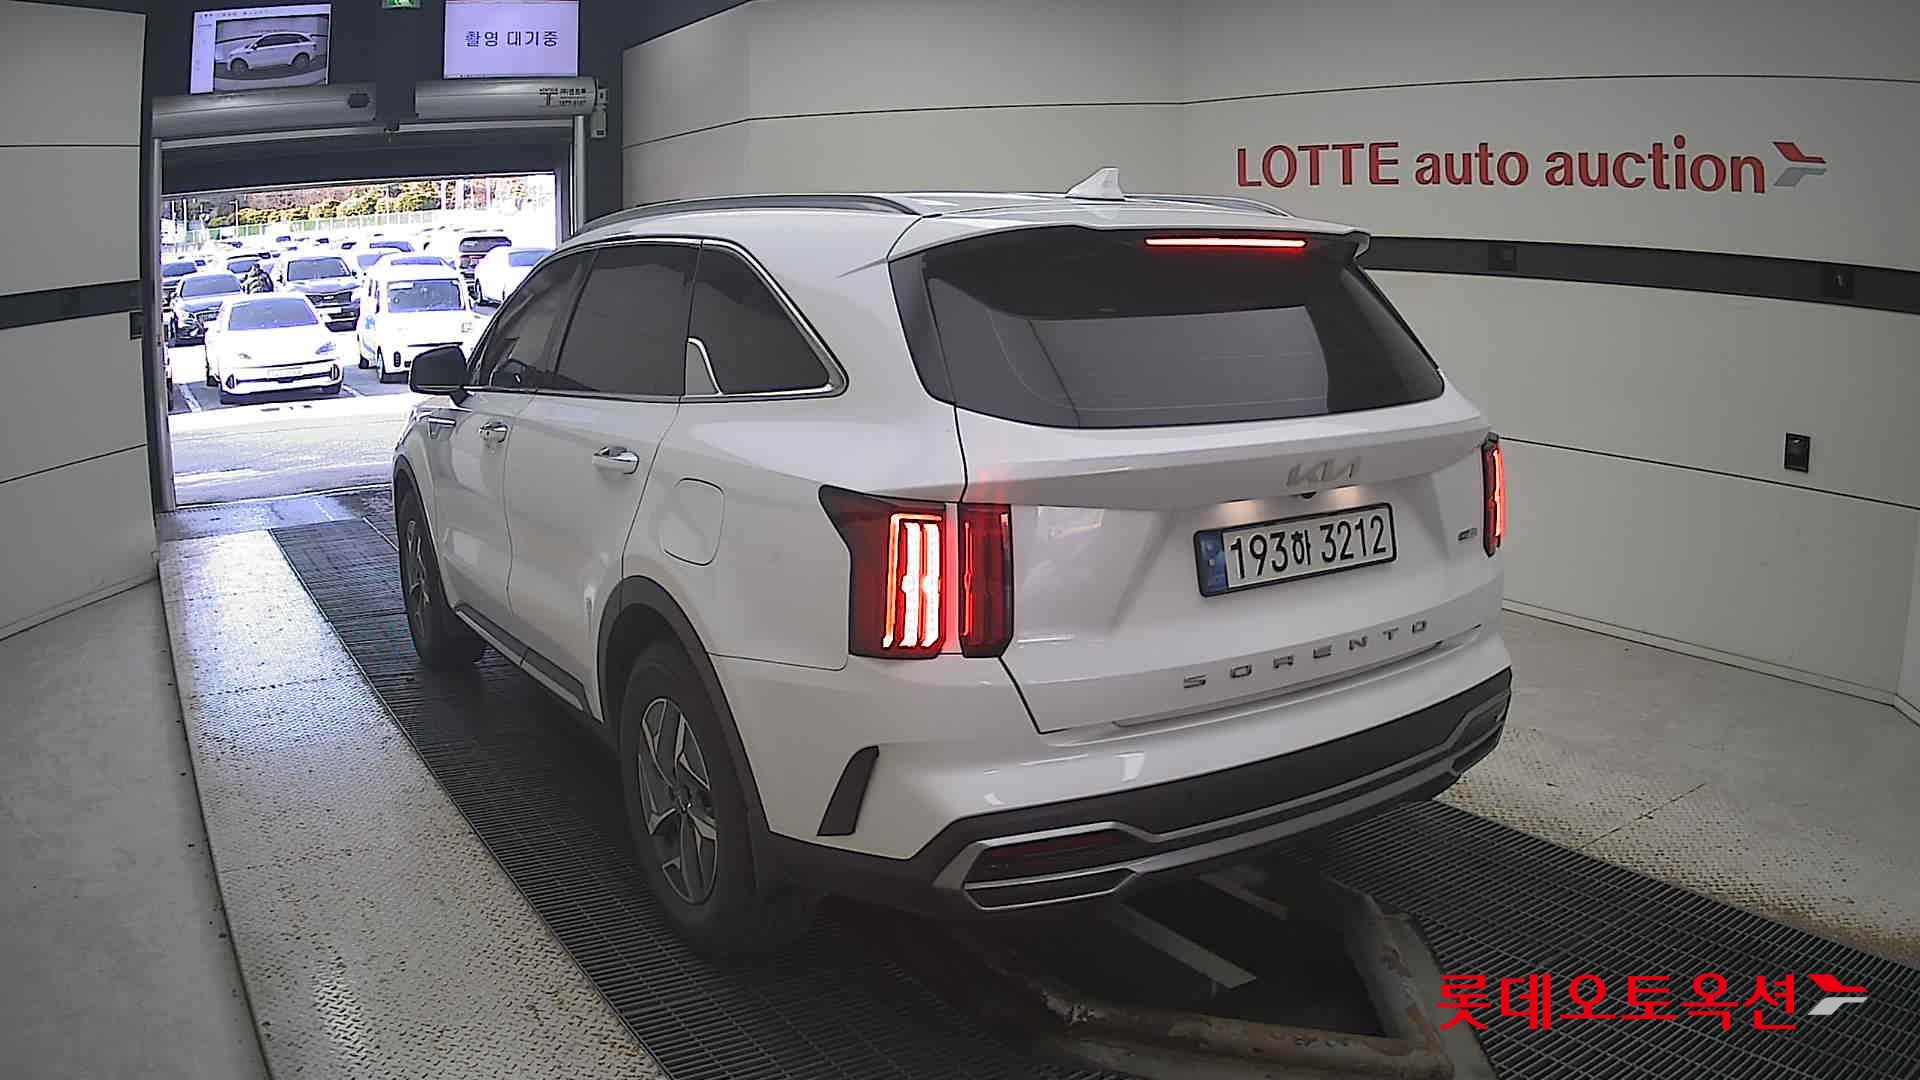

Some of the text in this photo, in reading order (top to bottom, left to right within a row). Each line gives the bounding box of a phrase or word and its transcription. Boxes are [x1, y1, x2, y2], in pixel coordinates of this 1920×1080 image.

[507, 31, 557, 47] 대기중
[1237, 135, 1766, 194] LOTTE auto auction
[1230, 515, 1387, 579] 193하 3212
[1183, 620, 1428, 689] SORENTO
